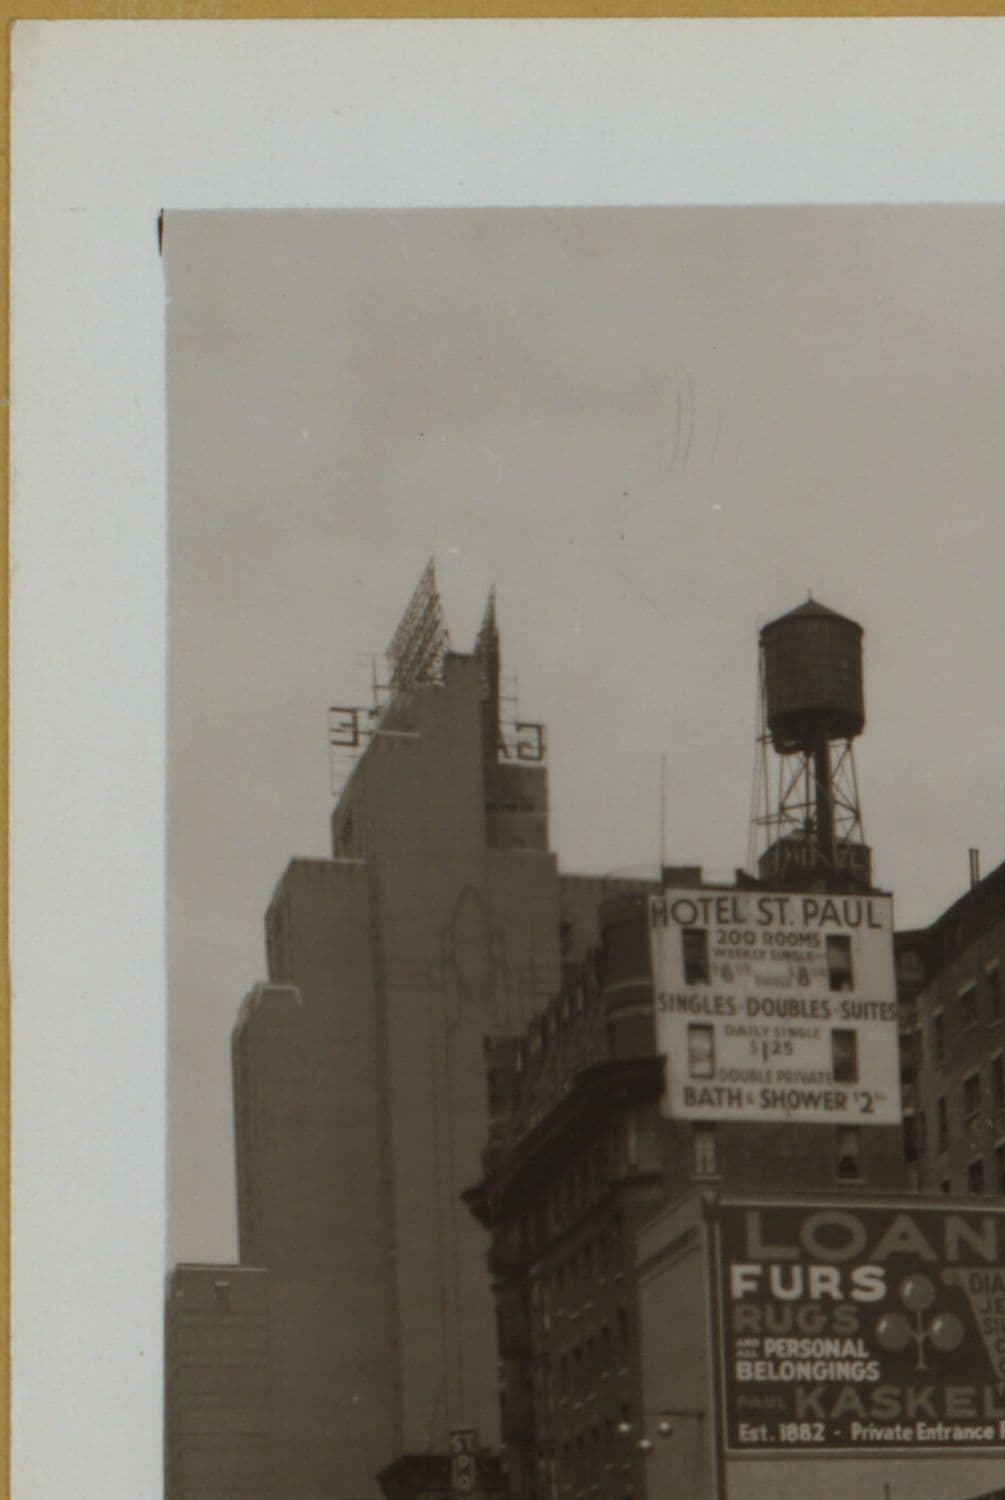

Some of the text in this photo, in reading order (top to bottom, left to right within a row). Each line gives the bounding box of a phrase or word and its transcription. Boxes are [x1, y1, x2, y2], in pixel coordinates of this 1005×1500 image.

[650, 897, 882, 929] HOTEL ST. PAUL
[717, 929, 821, 948] 200 ROOMS
[657, 993, 898, 1021] SINGLES DOUBLES SUITES
[724, 1024, 820, 1039] DAILY SINGLE
[718, 1069, 833, 1084] DOUBLE PRIVATE
[683, 1087, 742, 1108] BATH
[760, 1088, 847, 1111] SHOWER
[730, 1264, 887, 1302] FURS
[734, 1303, 860, 1335] RUGS
[764, 1338, 869, 1359] PERSONAL
[736, 1360, 881, 1382] BELONGINGS
[738, 1423, 776, 1442] Est.
[779, 1422, 825, 1442] 1882
[851, 1421, 913, 1441] Private
[917, 1421, 994, 1441] Entrance
